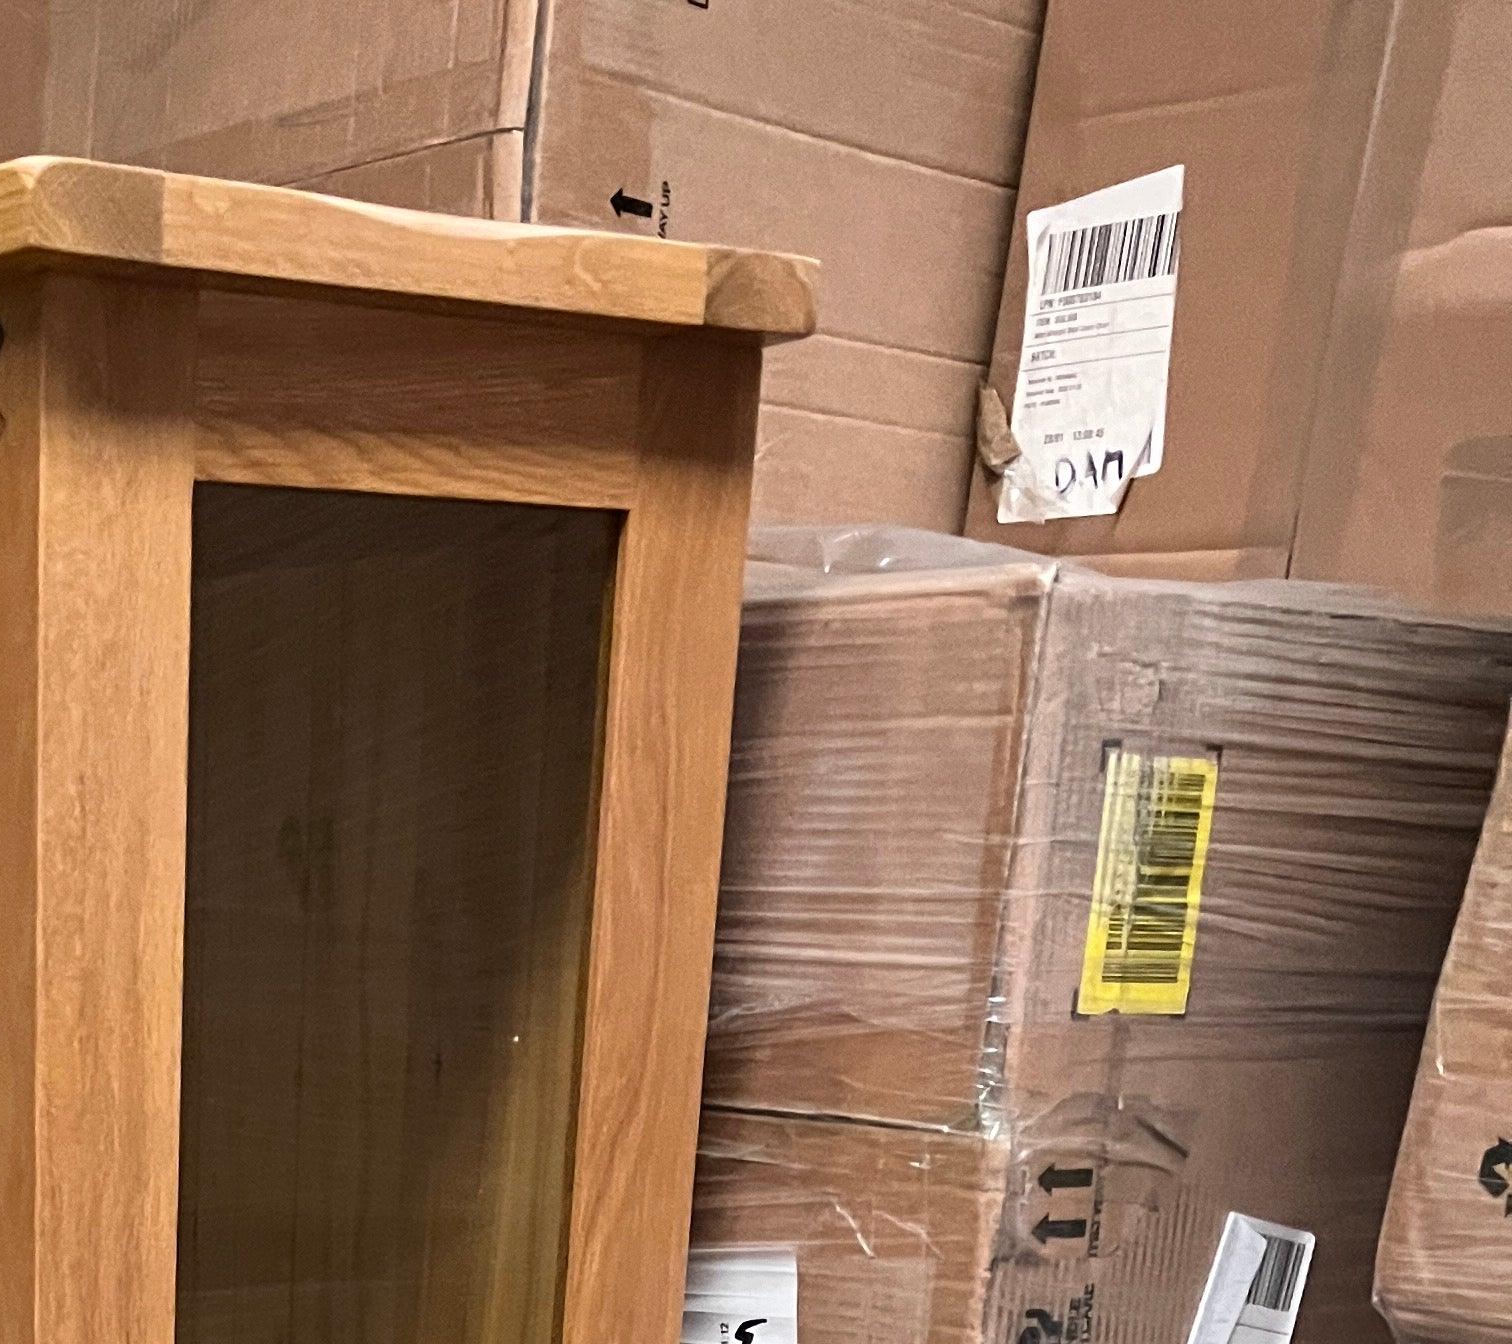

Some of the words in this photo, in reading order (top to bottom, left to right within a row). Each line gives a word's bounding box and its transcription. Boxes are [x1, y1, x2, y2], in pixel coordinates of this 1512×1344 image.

[662, 181, 671, 207] UP
[657, 209, 668, 239] AY
[1055, 449, 1124, 495] DAM
